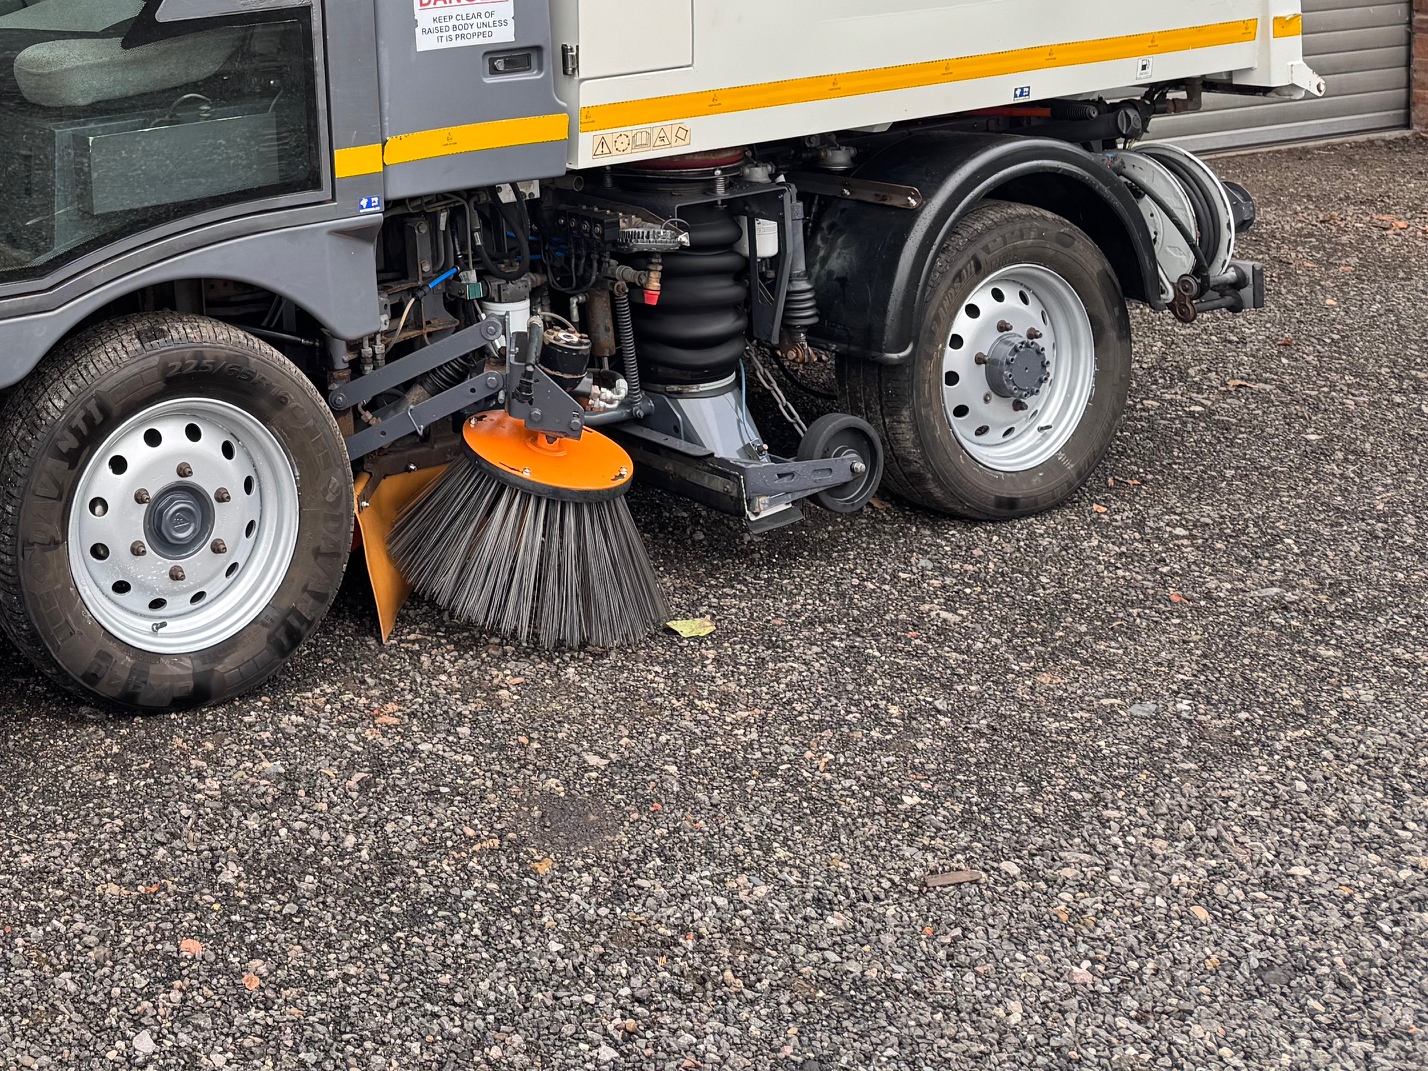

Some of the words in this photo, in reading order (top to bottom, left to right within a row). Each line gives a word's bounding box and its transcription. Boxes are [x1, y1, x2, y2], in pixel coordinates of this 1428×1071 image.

[432, 15, 454, 24] KEEP
[455, 12, 483, 22] CLEAR
[484, 11, 496, 19] OF
[421, 25, 450, 36] RAISED
[452, 23, 474, 32] BODY
[476, 19, 509, 29] UNLESS
[436, 36, 444, 44] IT
[455, 30, 494, 41] PROPPED
